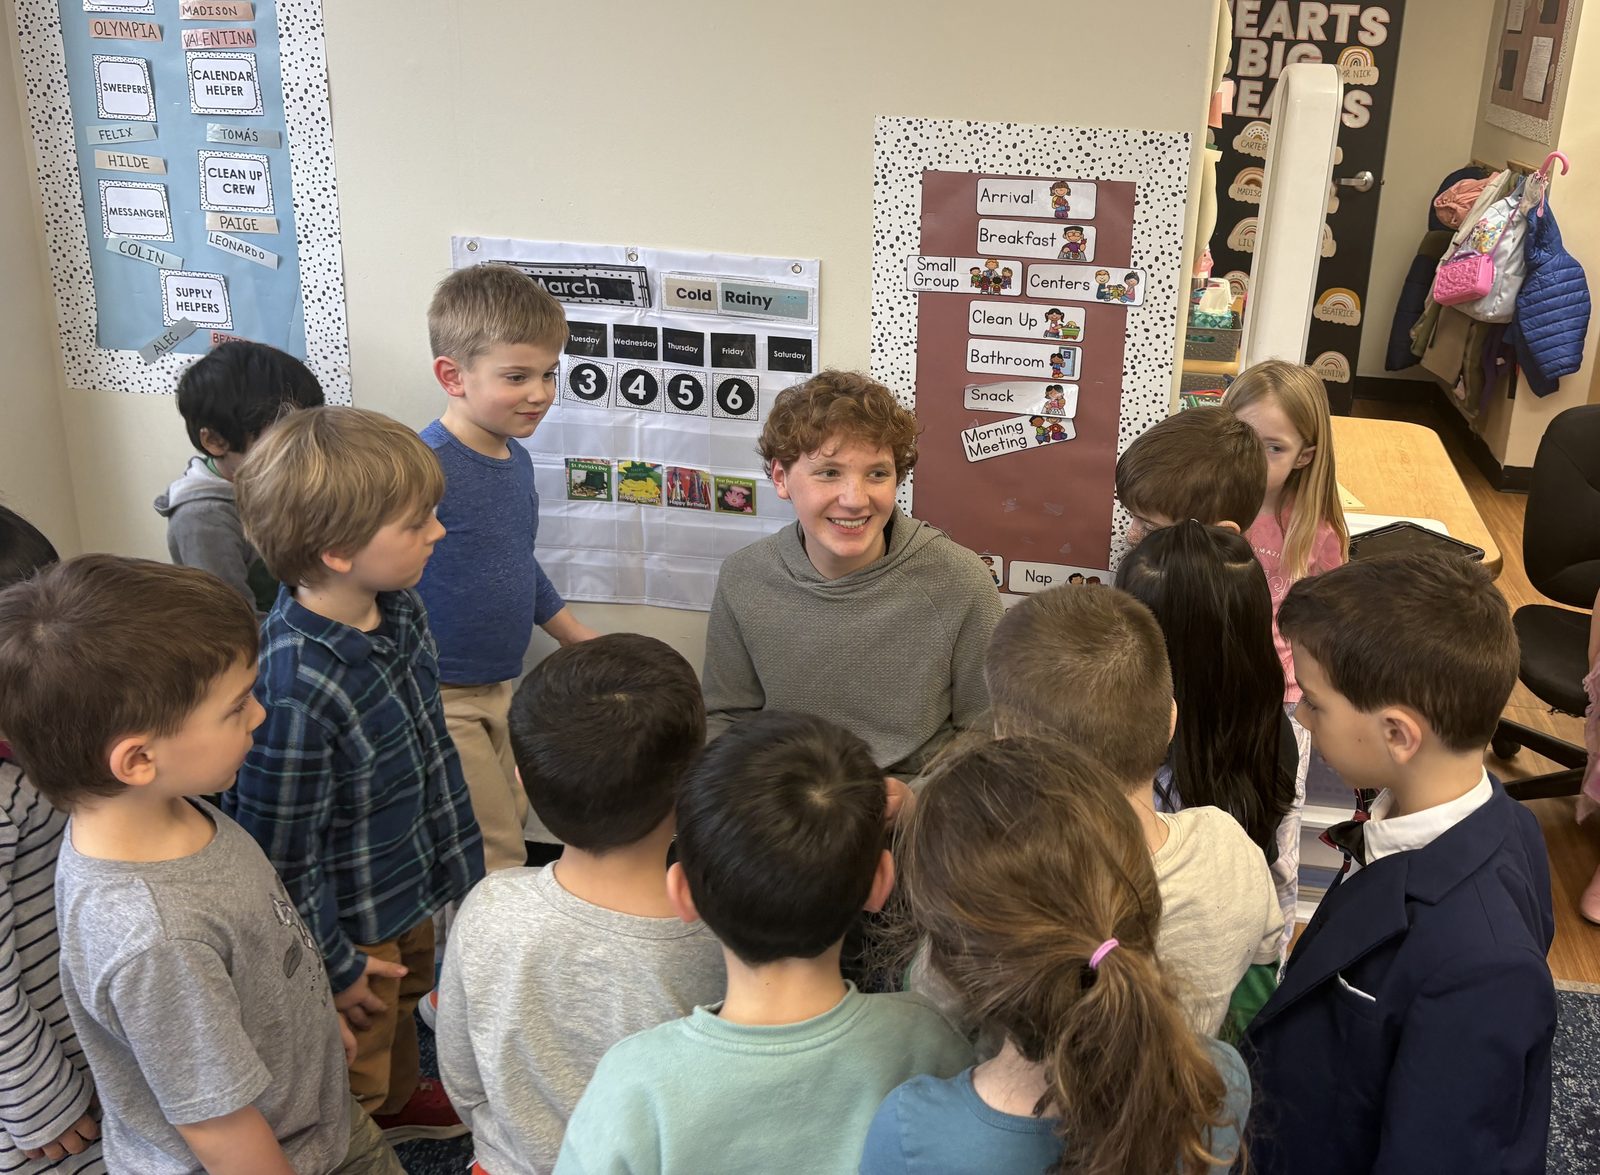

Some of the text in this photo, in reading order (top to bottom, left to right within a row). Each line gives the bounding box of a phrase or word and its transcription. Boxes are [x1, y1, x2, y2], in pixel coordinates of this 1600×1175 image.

[182, 5, 238, 17] MADISON
[94, 21, 157, 39] OLYMPIA
[1234, 0, 1390, 47] EARTS
[183, 31, 254, 47] VALENTINA
[193, 69, 254, 82] CALENDAR
[1353, 70, 1371, 78] NICK
[103, 82, 148, 94] SWEEPERS
[206, 83, 244, 97] HELPER
[99, 129, 133, 140] FELIX
[220, 128, 259, 142] TOMÁS
[1241, 140, 1267, 151] CARTER
[108, 155, 150, 169] HILDE
[208, 168, 263, 181] CLEAN UP
[223, 183, 255, 195] CREW
[980, 188, 1034, 205] Arrival
[109, 207, 165, 219] MESSANGER
[219, 216, 260, 231] PAIGE
[979, 227, 1057, 248] Breakfast
[118, 240, 165, 265] COLIN
[208, 232, 265, 260] LEONARDO
[917, 257, 957, 272] Small
[913, 272, 960, 291] Group
[1030, 274, 1091, 292] Centers
[176, 287, 213, 299] SUPPLY
[676, 287, 773, 311] Cold Rainy
[176, 301, 220, 314] HELPERS
[1322, 306, 1355, 318] BEATRICE
[972, 310, 1039, 330] Clean Up
[153, 331, 180, 356] ALEC
[570, 333, 600, 345] Tuesday
[614, 338, 657, 349] Wednesday
[667, 342, 699, 354] Thursday
[722, 347, 745, 357] Friday
[773, 350, 806, 361] Saturday
[970, 350, 1045, 369] Bathroom
[578, 369, 598, 395] 3
[627, 375, 647, 400] 4
[677, 380, 694, 406] 5
[726, 384, 744, 410] 6
[971, 388, 1014, 402] Snack
[964, 422, 1024, 444] Morning
[968, 436, 1028, 458] Meeting
[1025, 569, 1052, 586] Nap
